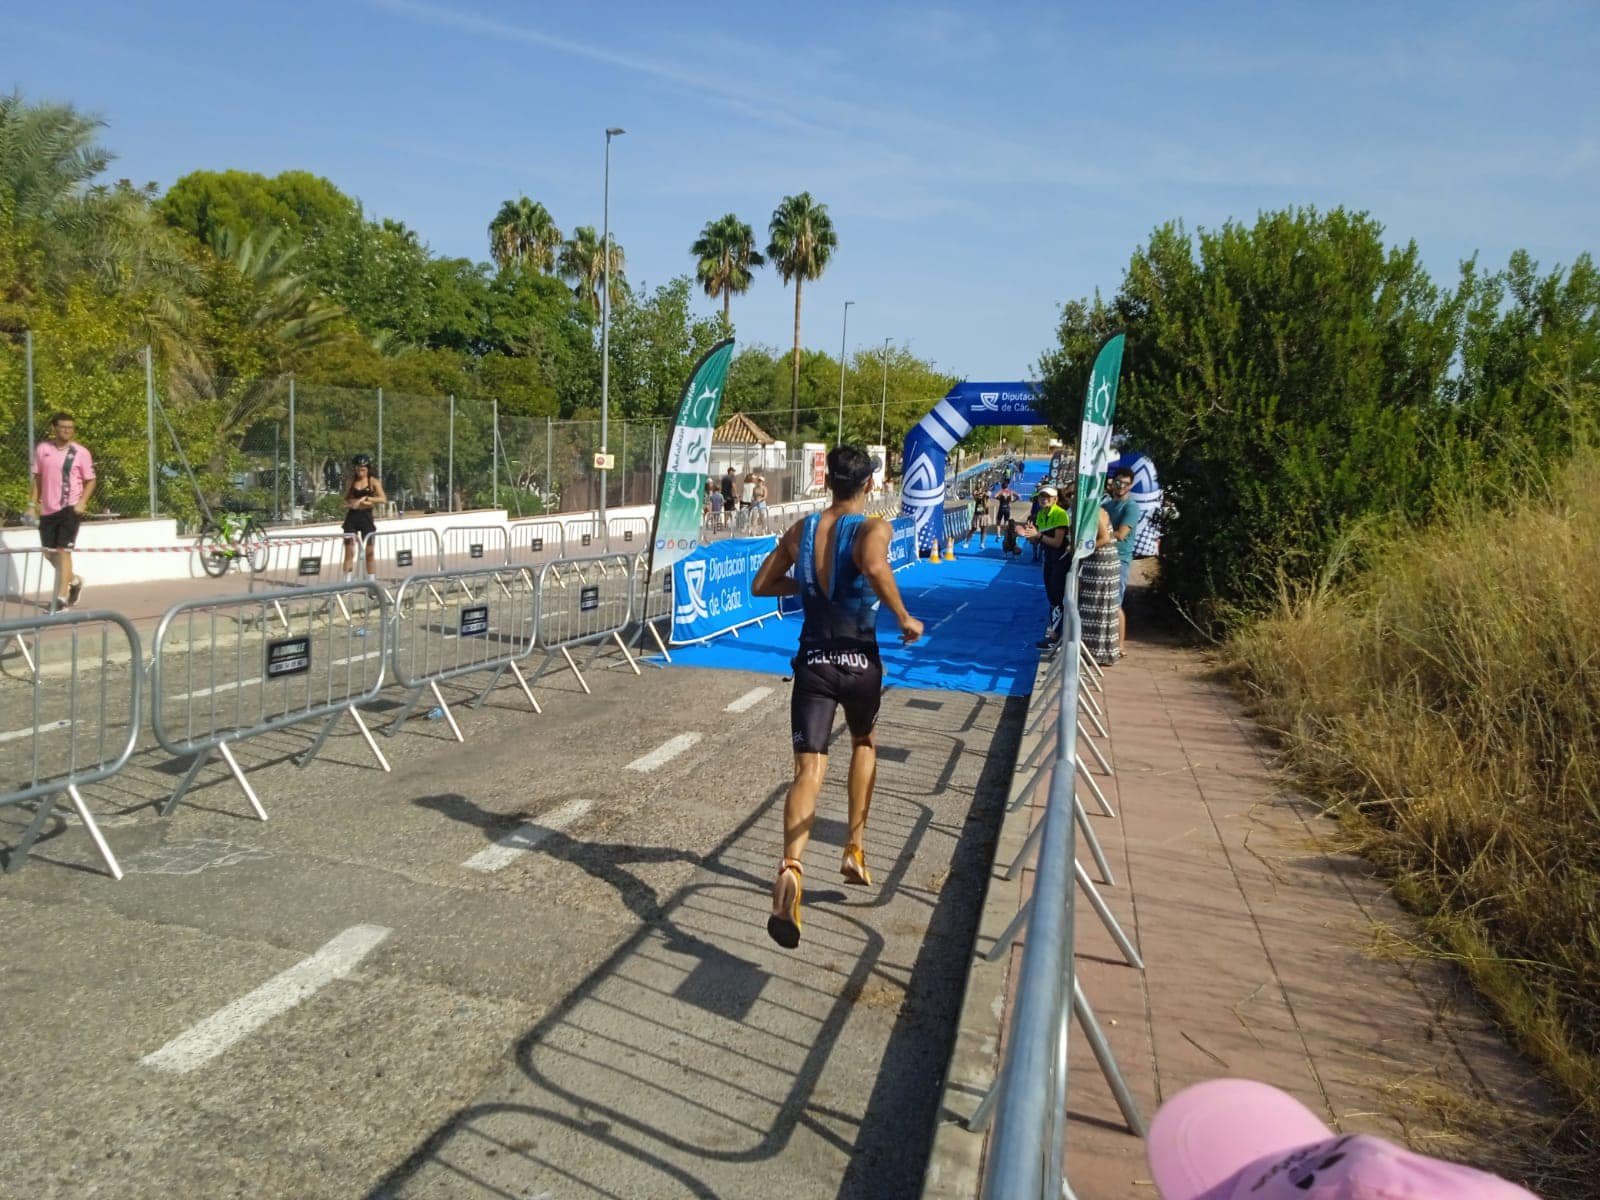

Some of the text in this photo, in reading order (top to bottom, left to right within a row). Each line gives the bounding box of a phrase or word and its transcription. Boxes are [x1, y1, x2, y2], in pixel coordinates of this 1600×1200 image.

[1001, 404, 1012, 412] de
[709, 553, 746, 583] Diputación
[709, 587, 742, 616] de Cádiz
